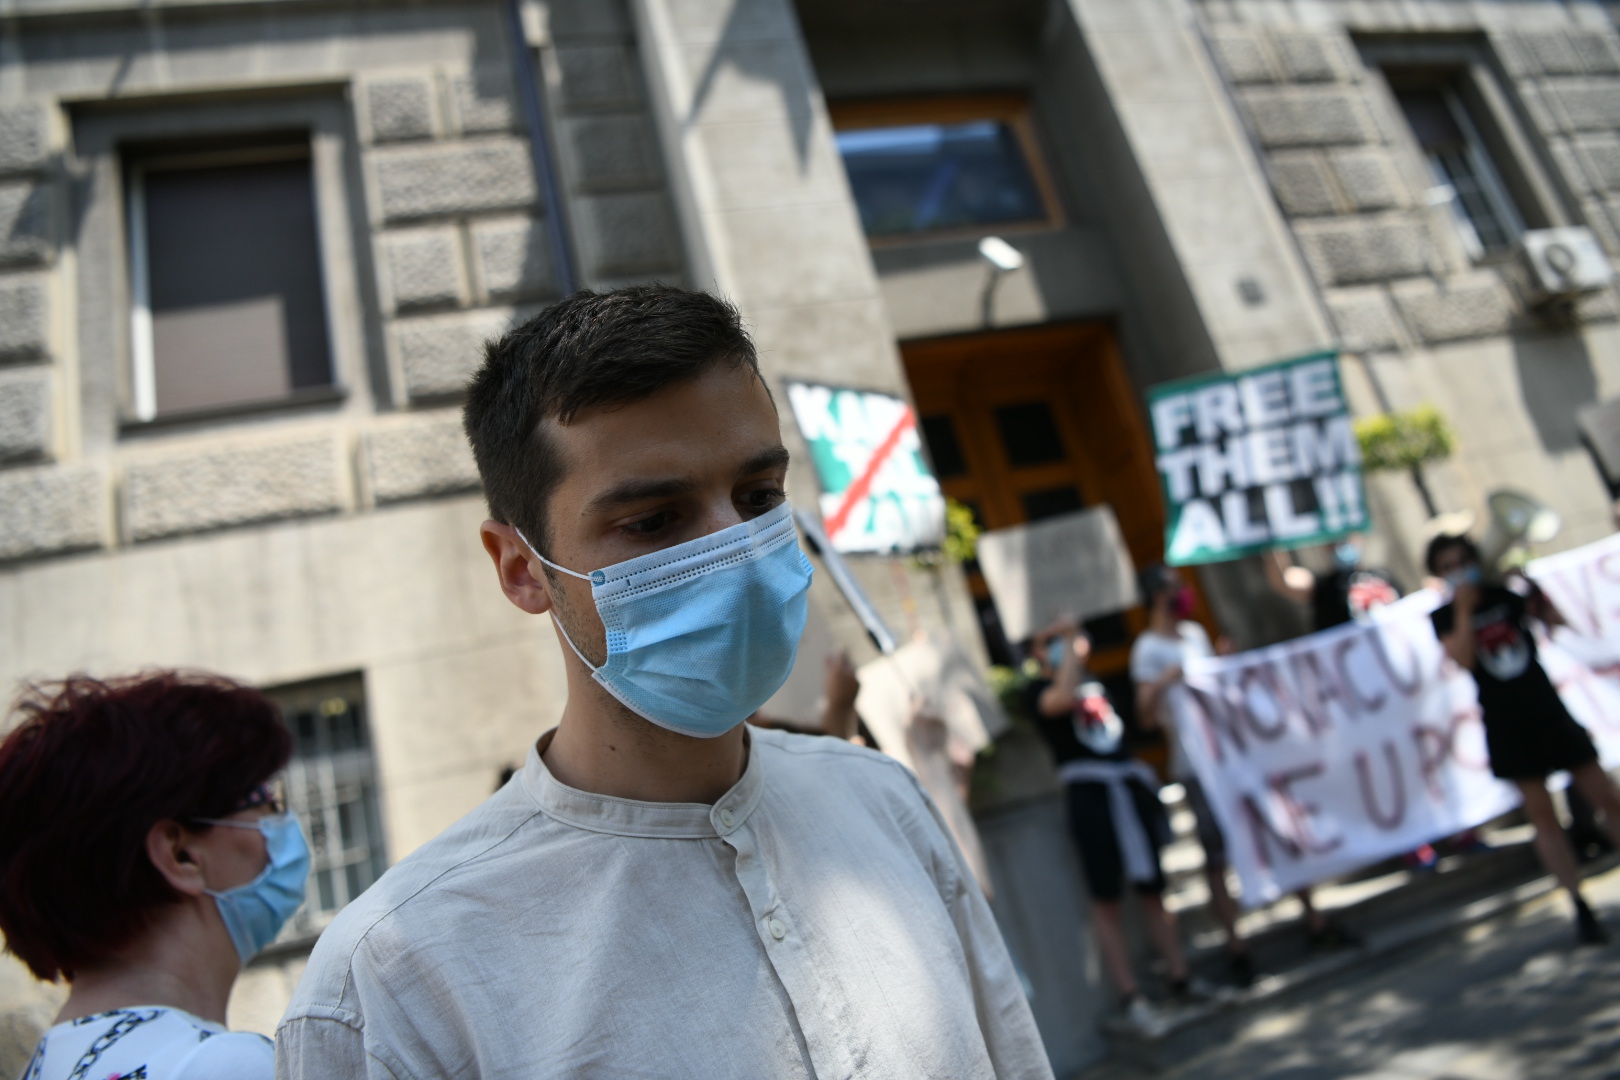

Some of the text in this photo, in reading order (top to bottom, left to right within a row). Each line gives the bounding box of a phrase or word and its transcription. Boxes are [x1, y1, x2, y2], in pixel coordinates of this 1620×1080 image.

[1153, 358, 1341, 449] FREE
[1156, 415, 1362, 502] THEM
[1167, 470, 1364, 560] ALL!!
